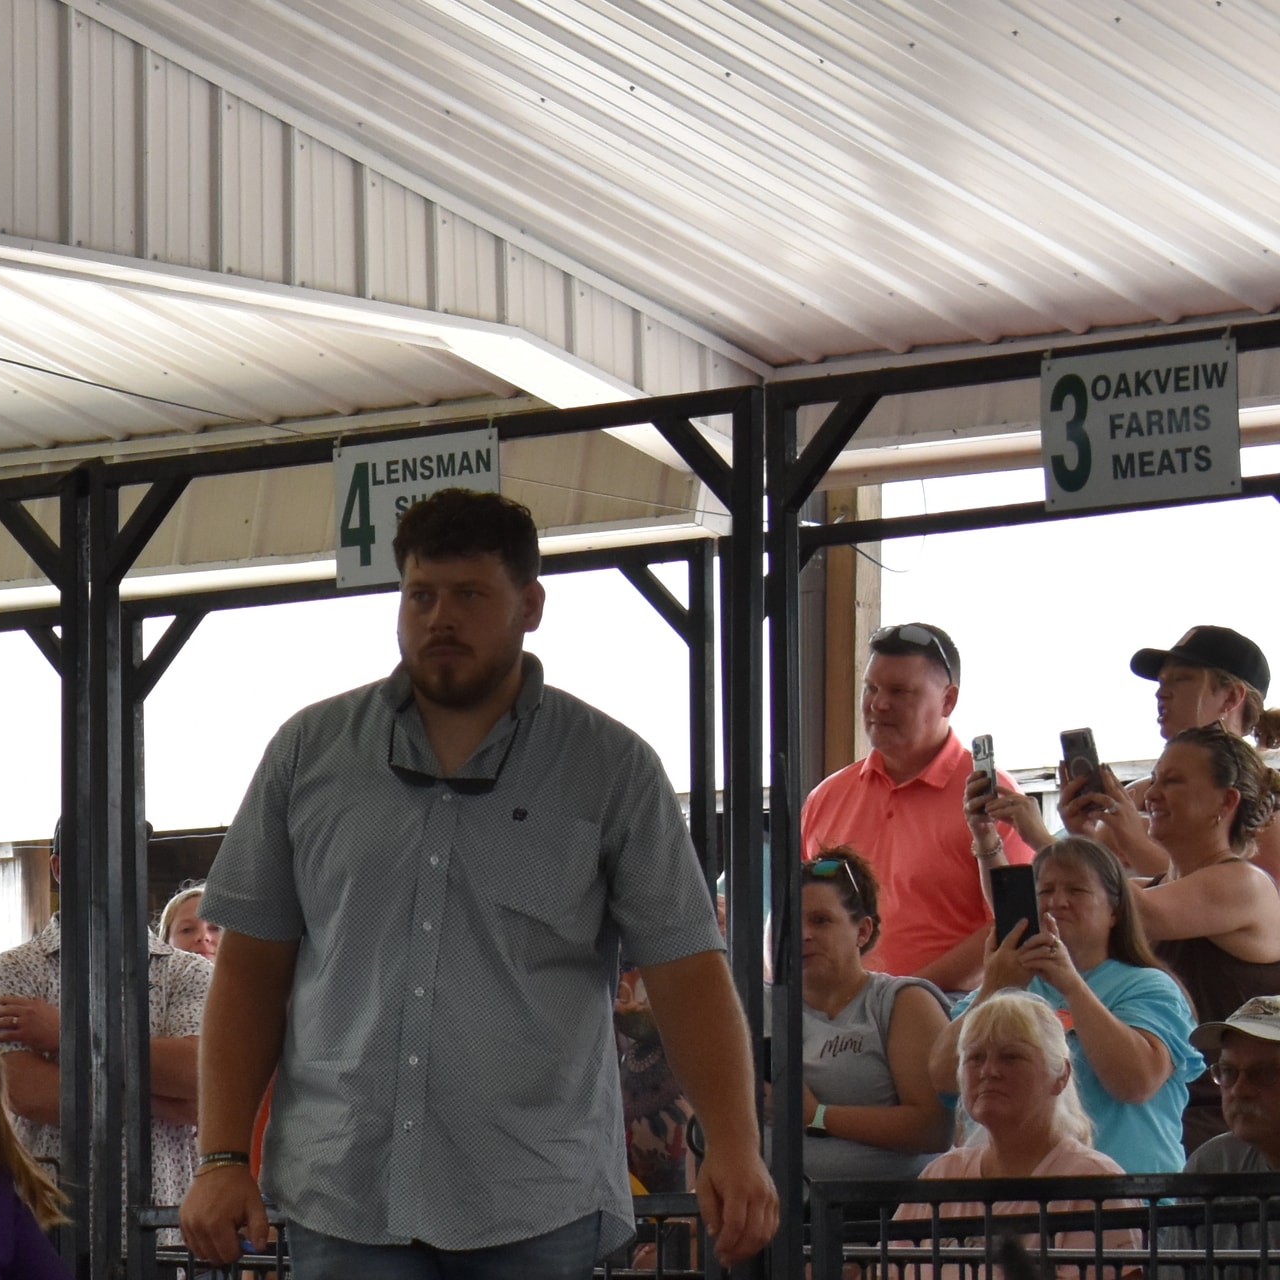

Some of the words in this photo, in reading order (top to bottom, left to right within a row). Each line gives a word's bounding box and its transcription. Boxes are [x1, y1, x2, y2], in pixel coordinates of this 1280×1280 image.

[1091, 362, 1229, 401] OAKVEIW
[1050, 373, 1092, 492] 3
[1108, 404, 1212, 439] FARMS
[371, 448, 492, 486] LENSMAN
[1111, 445, 1213, 480] MEATS
[340, 462, 376, 567] 4
[819, 1035, 864, 1060] Mimi
